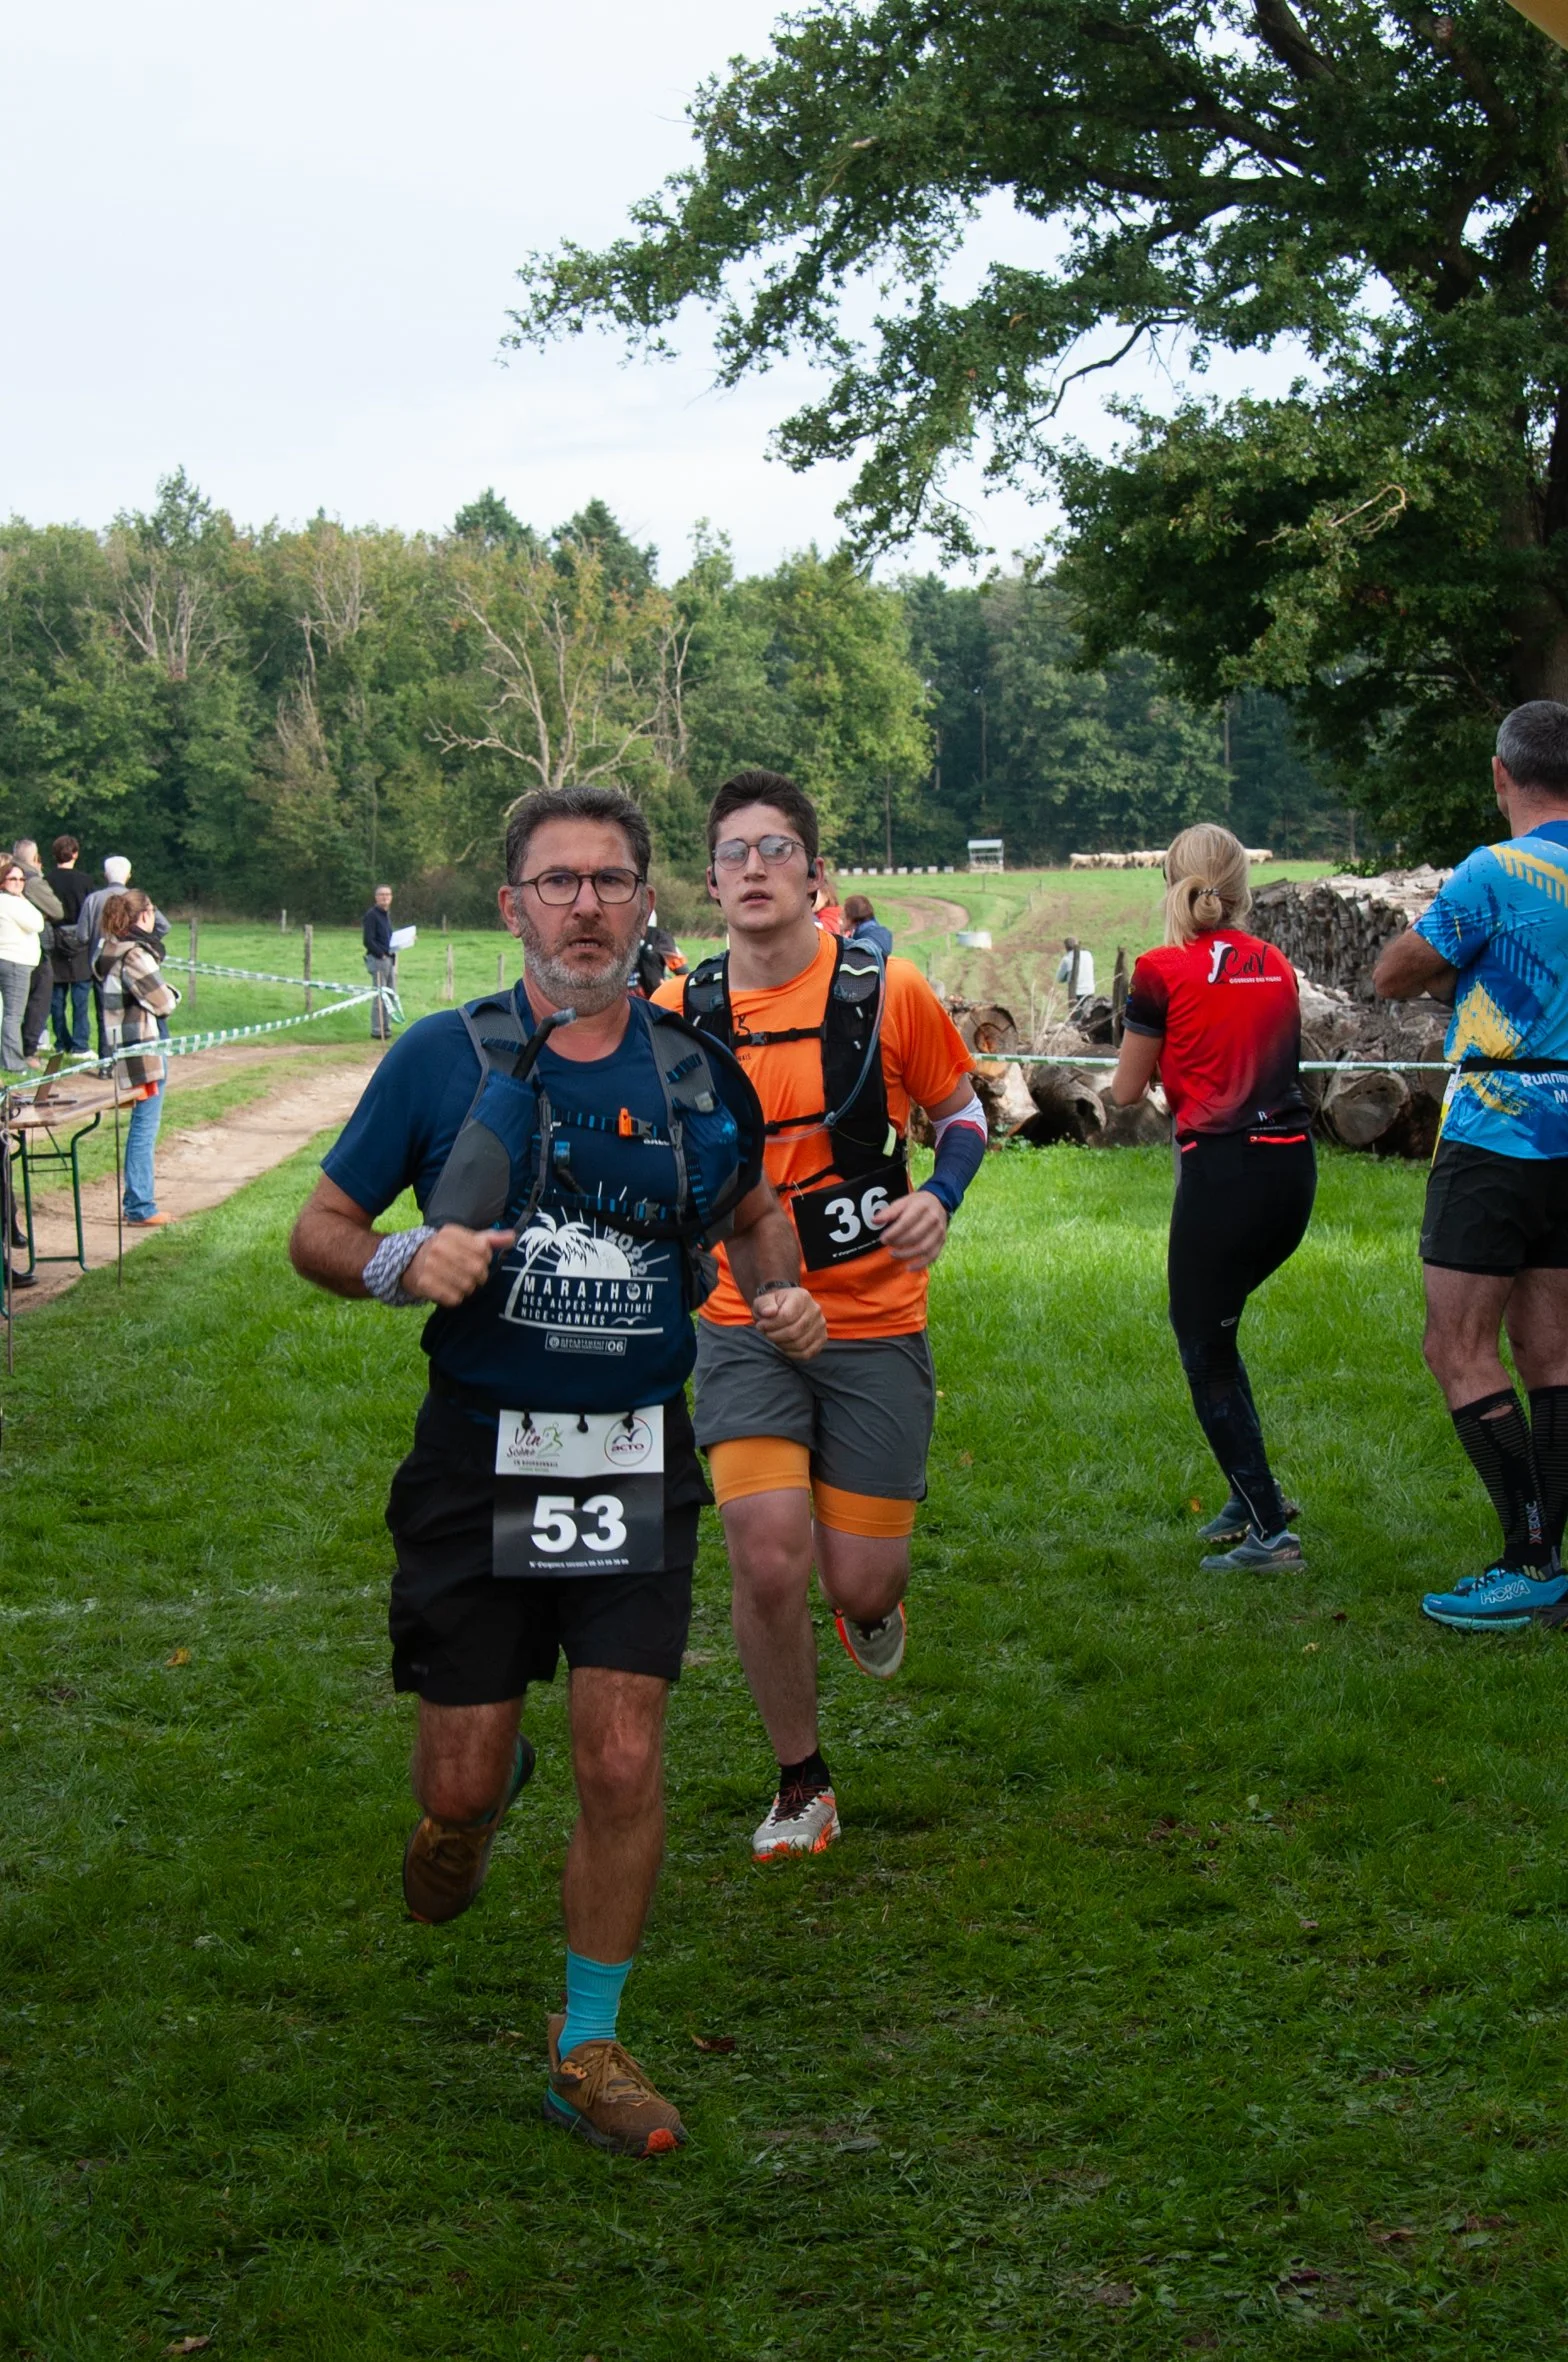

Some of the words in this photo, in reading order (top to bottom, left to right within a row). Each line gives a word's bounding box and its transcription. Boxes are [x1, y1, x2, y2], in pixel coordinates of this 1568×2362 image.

[1520, 1072, 1568, 1087] Runnin
[824, 1186, 890, 1243] 36
[522, 1294, 543, 1307] DES
[524, 1275, 653, 1301] MARATHON
[607, 1340, 623, 1353] 06
[531, 1494, 627, 1553] 53
[1480, 1579, 1531, 1605] HOKA
